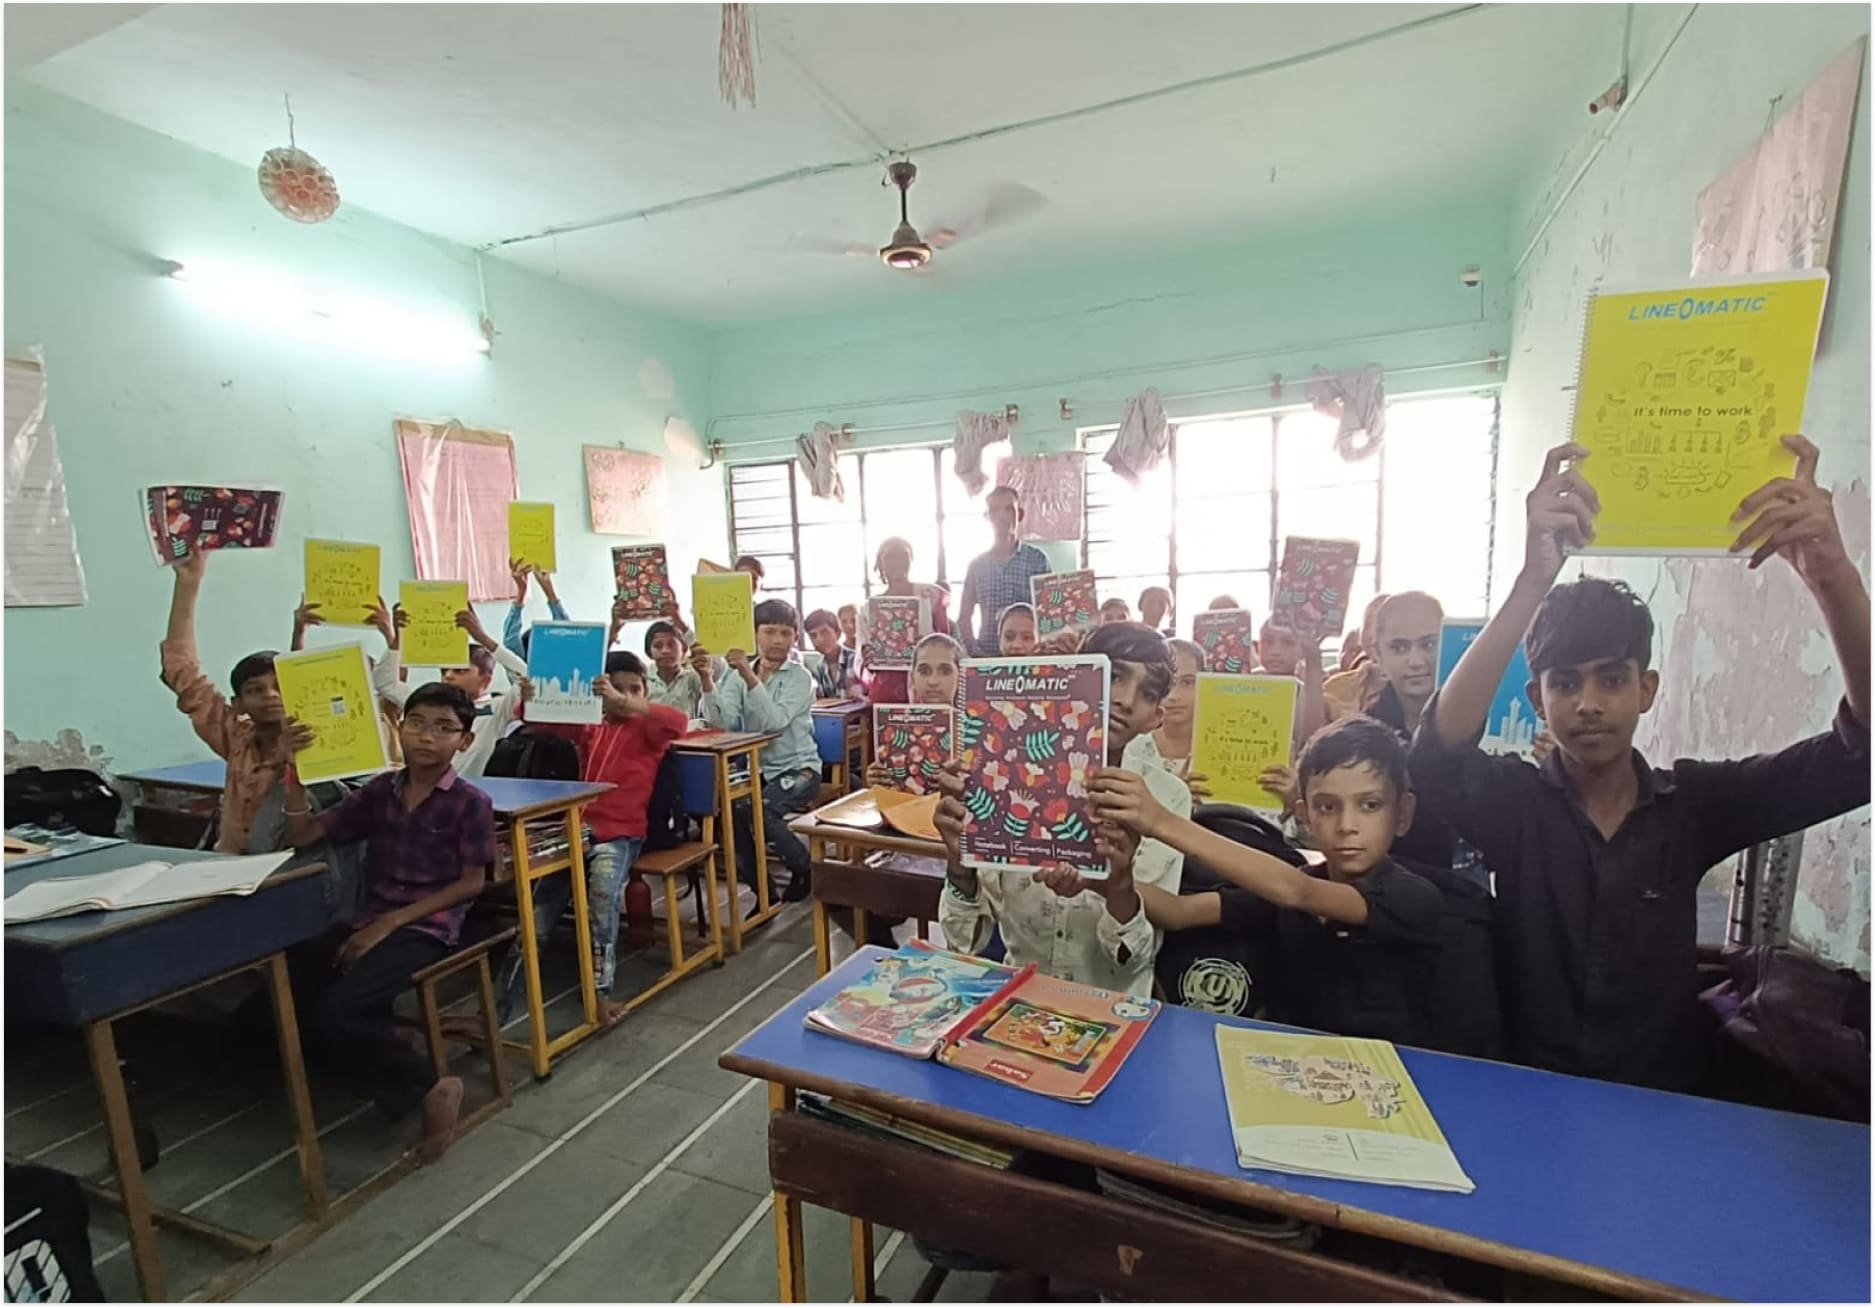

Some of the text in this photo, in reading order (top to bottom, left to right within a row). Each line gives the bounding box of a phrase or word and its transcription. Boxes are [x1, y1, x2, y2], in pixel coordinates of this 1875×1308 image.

[1628, 297, 1766, 320] LINEOMATIC
[1634, 405, 1753, 417] It's time to work
[985, 676, 1069, 694] LINEOMATIC
